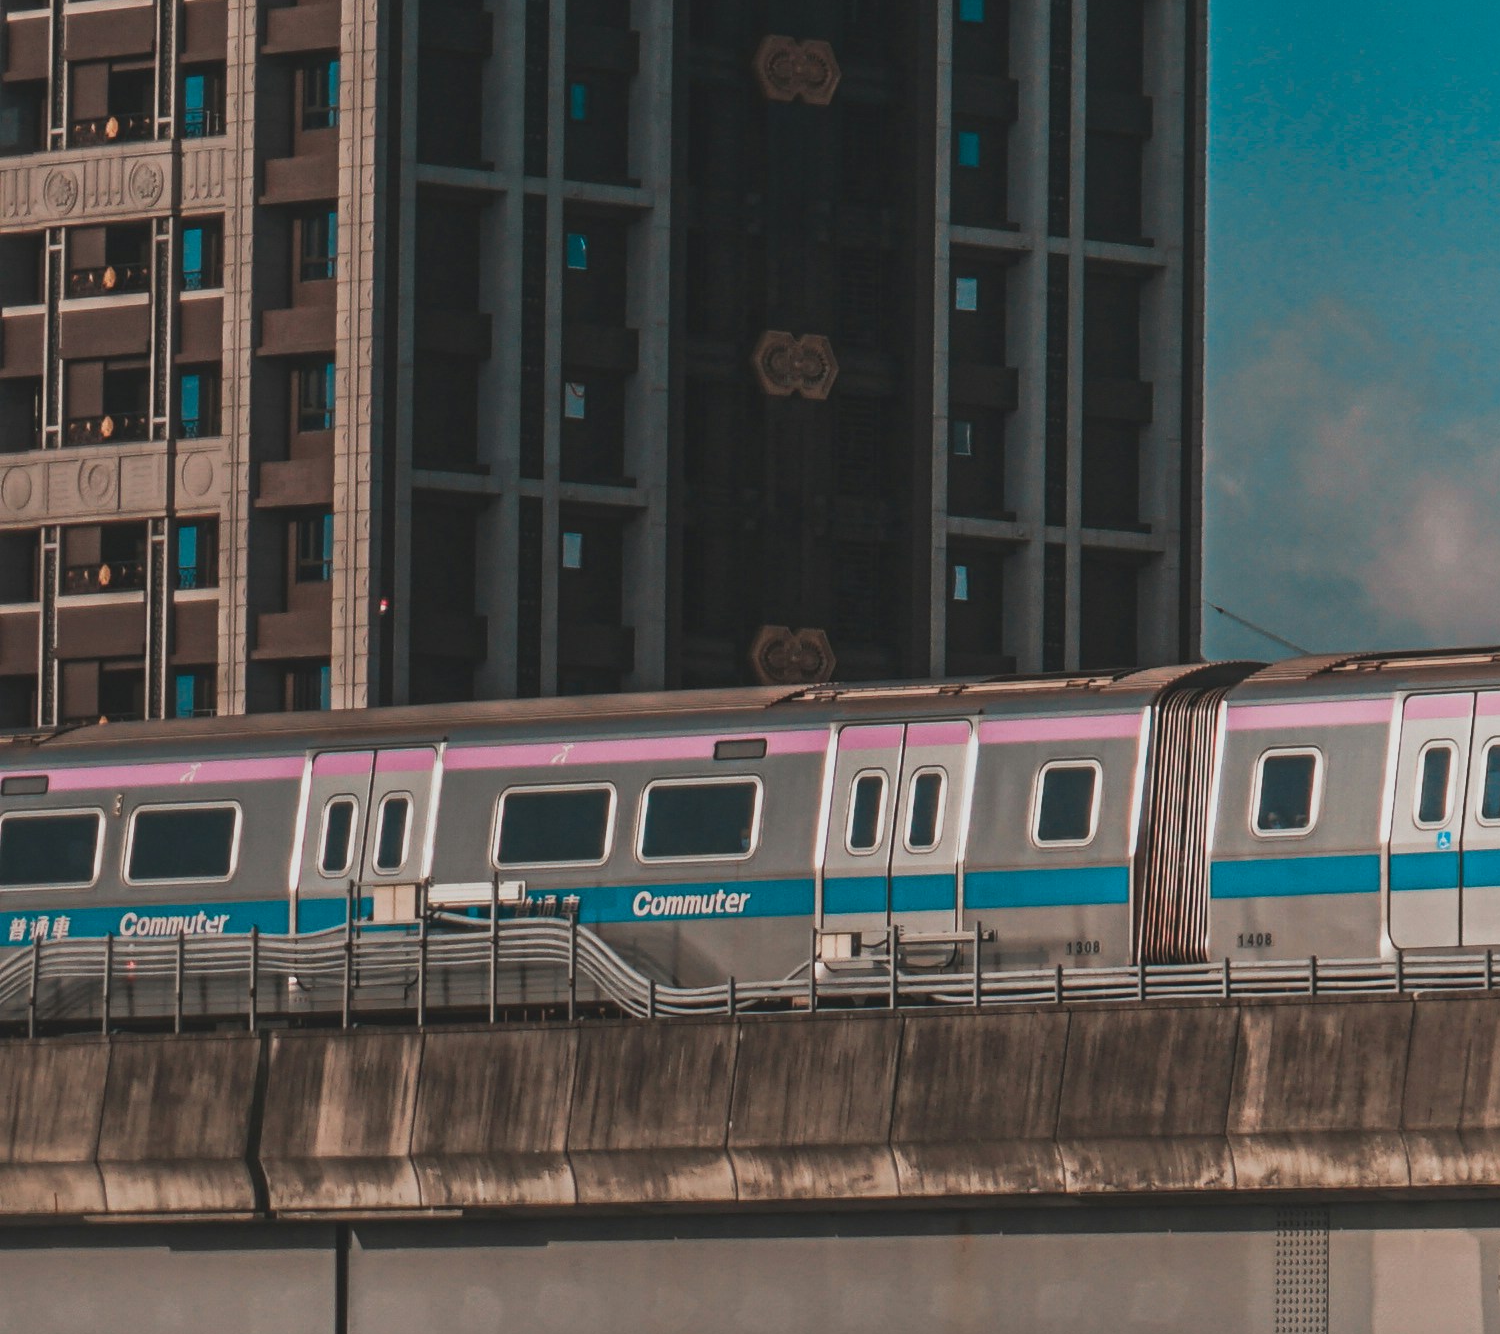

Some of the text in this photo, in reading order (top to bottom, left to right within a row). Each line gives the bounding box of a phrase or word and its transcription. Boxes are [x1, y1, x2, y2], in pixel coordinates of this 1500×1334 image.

[515, 894, 581, 917] 普通車
[632, 889, 751, 916] Commuter
[9, 915, 70, 941] 普通車
[119, 911, 230, 937] Commuter
[1066, 940, 1100, 955] 1308
[1237, 932, 1273, 948] 1408
